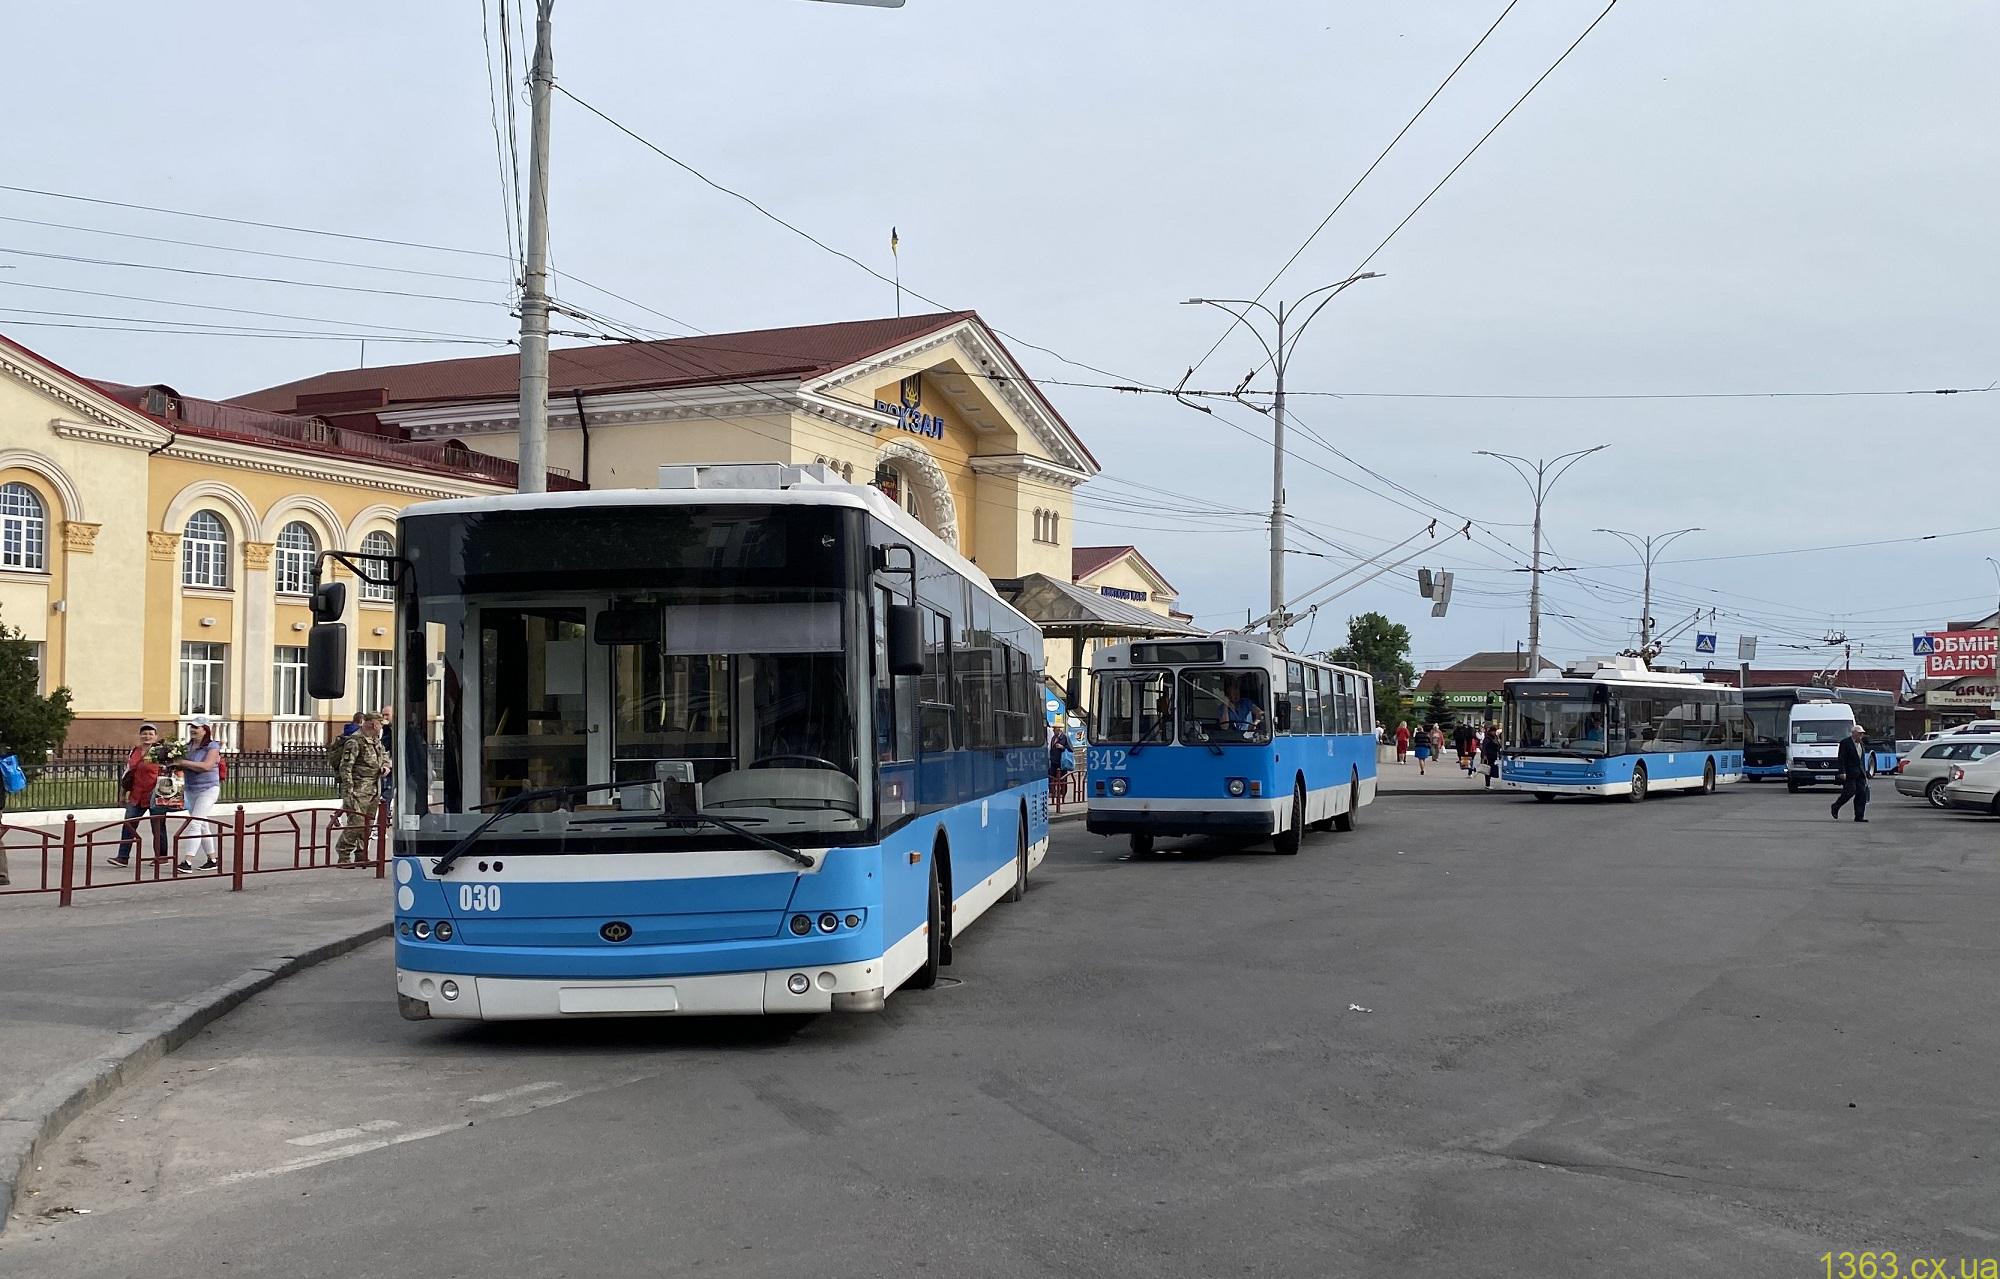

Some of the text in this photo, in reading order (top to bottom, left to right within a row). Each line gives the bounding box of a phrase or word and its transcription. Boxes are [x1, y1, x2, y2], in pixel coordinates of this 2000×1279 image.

[1933, 635, 1999, 653] ОБМІН
[1089, 749, 1127, 770] 342
[459, 884, 502, 912] 030
